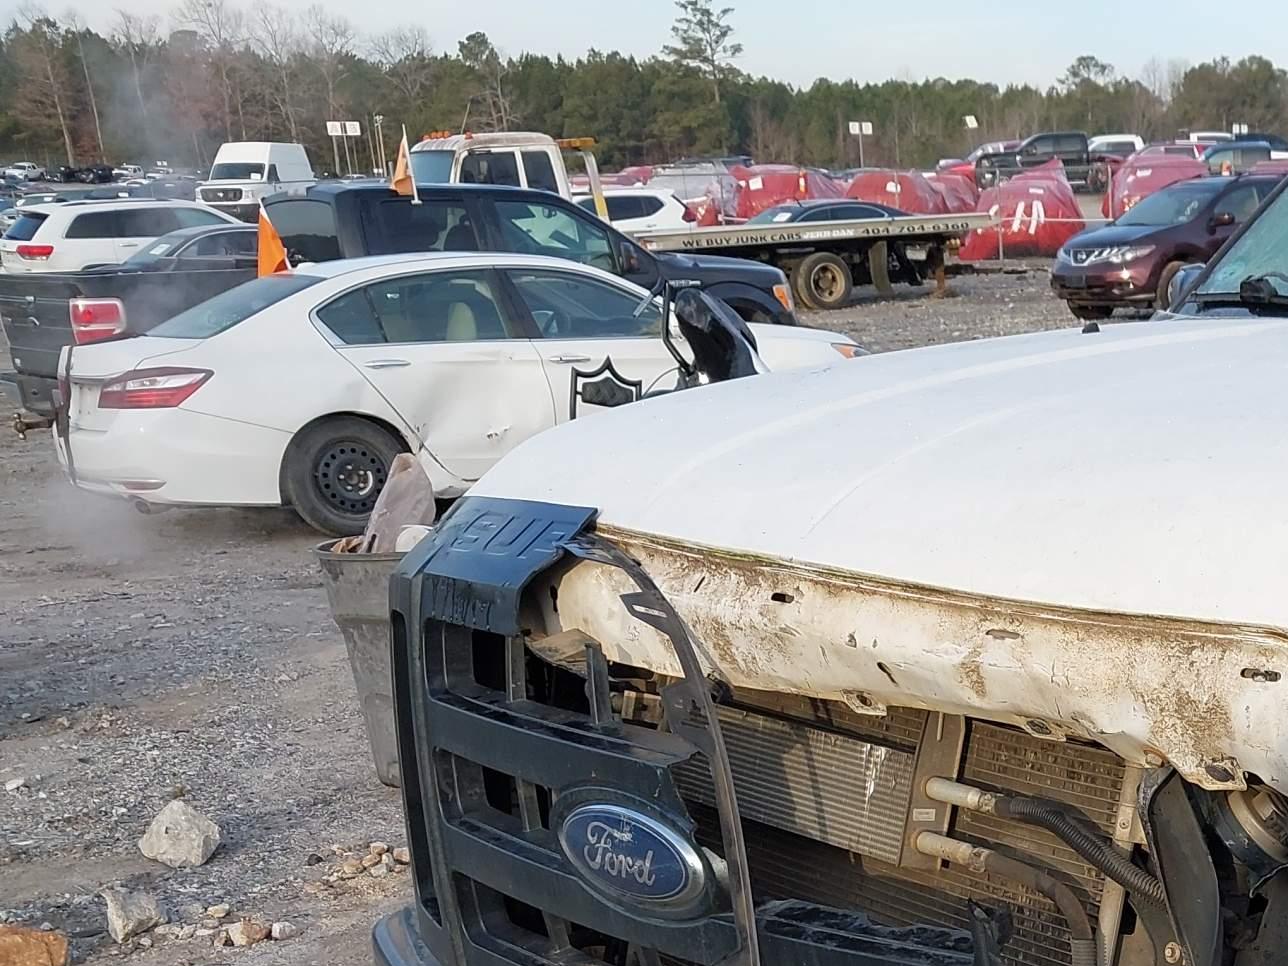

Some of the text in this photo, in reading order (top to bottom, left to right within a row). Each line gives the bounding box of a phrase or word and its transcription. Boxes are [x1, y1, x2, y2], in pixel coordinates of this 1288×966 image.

[862, 227, 890, 235] 404
[682, 232, 802, 248] WE BUY JUNK CARS
[584, 821, 656, 887] Ford
